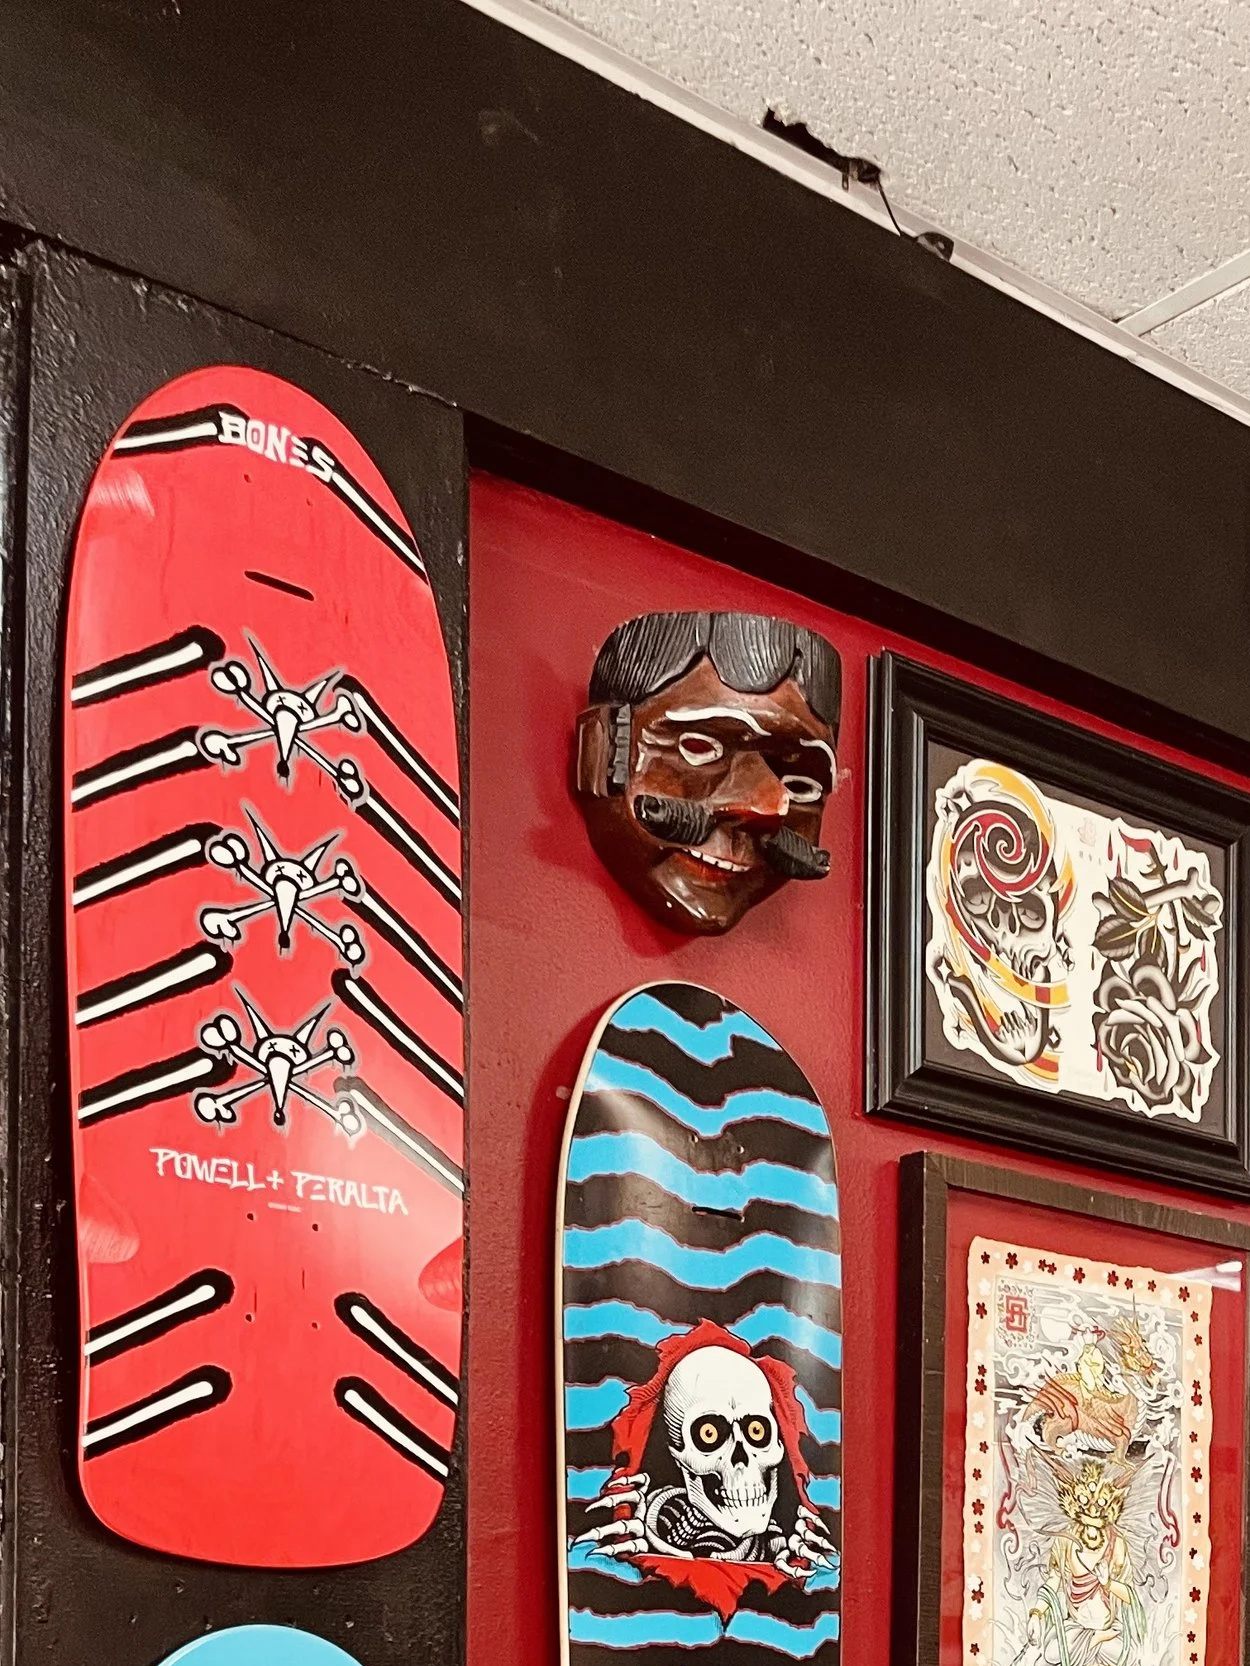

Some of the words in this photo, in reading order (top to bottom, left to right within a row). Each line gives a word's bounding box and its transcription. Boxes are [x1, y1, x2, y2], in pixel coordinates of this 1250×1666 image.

[217, 410, 335, 483] BONES
[149, 1147, 266, 1192] POWELL
[291, 1170, 409, 1215] PERALTA
